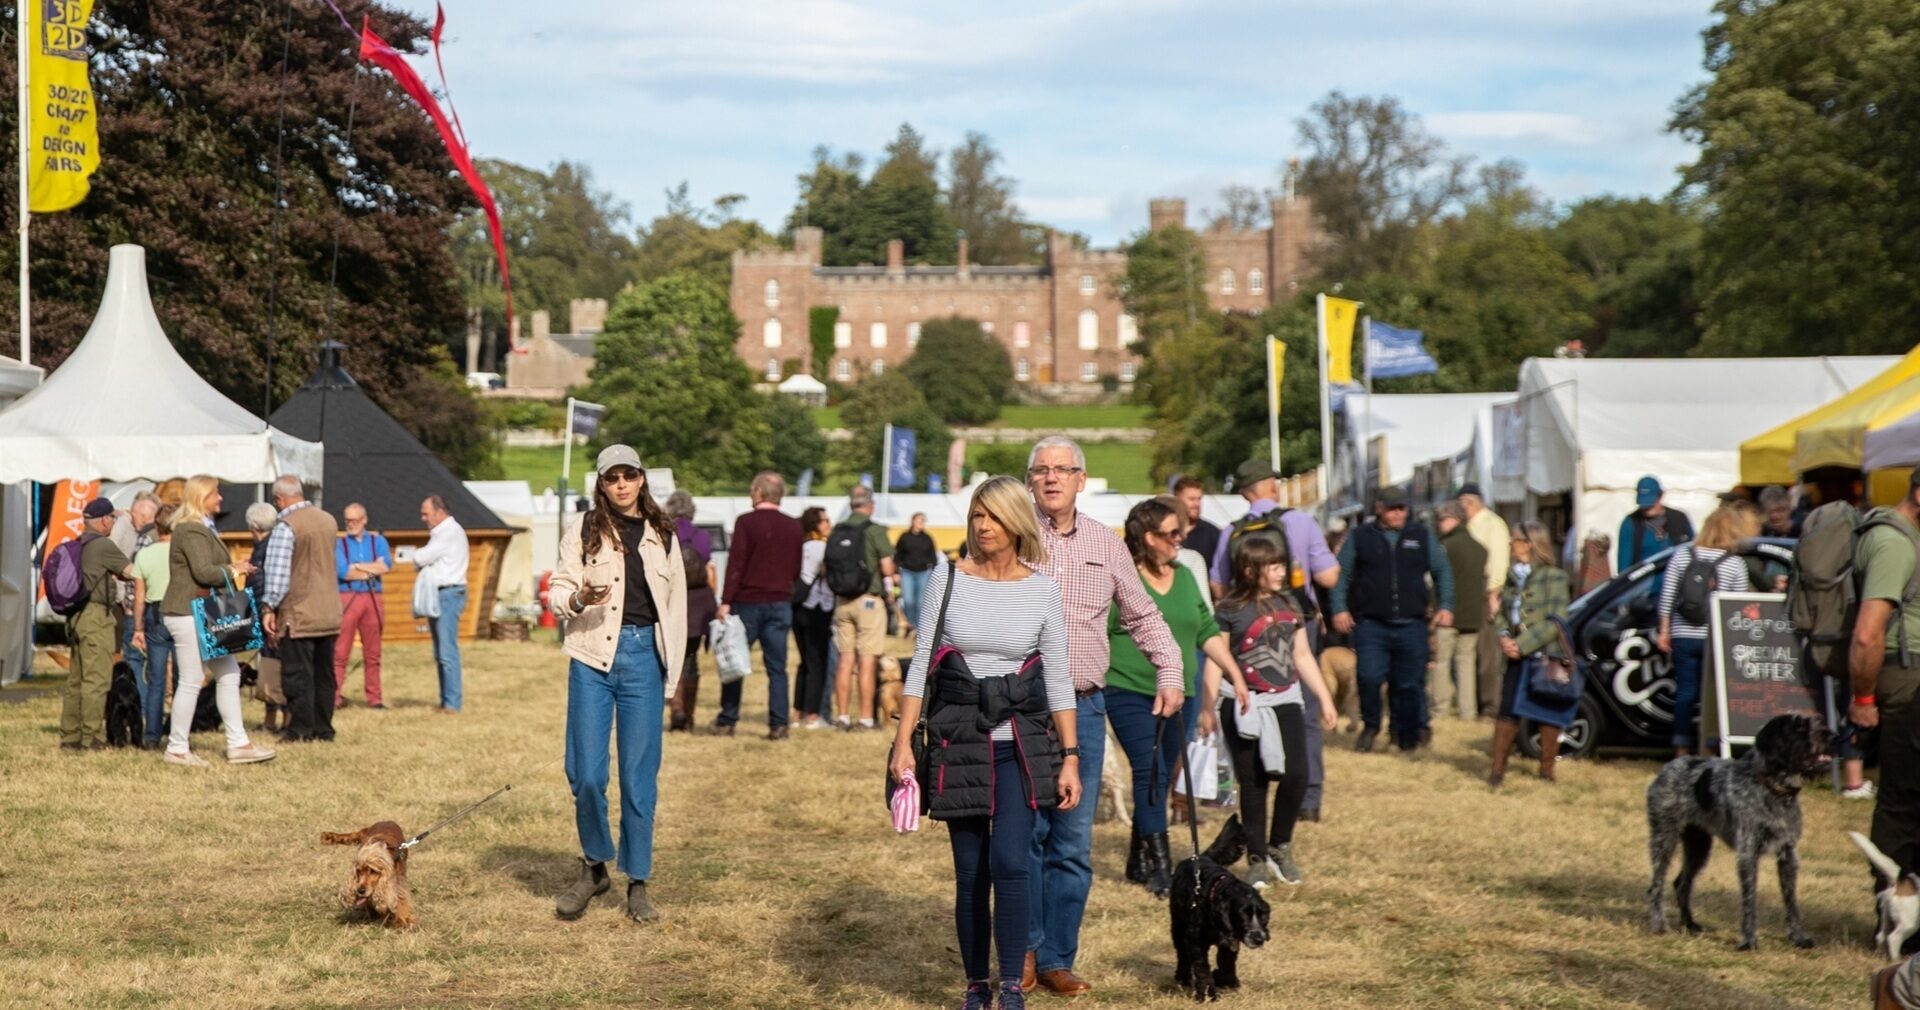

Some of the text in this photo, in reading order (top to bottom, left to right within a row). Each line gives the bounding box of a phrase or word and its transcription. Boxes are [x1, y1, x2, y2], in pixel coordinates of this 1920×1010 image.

[50, 0, 83, 22] 3D
[51, 26, 85, 50] 2D
[43, 136, 86, 156] DEIGN
[1742, 662, 1796, 681] OFFER
